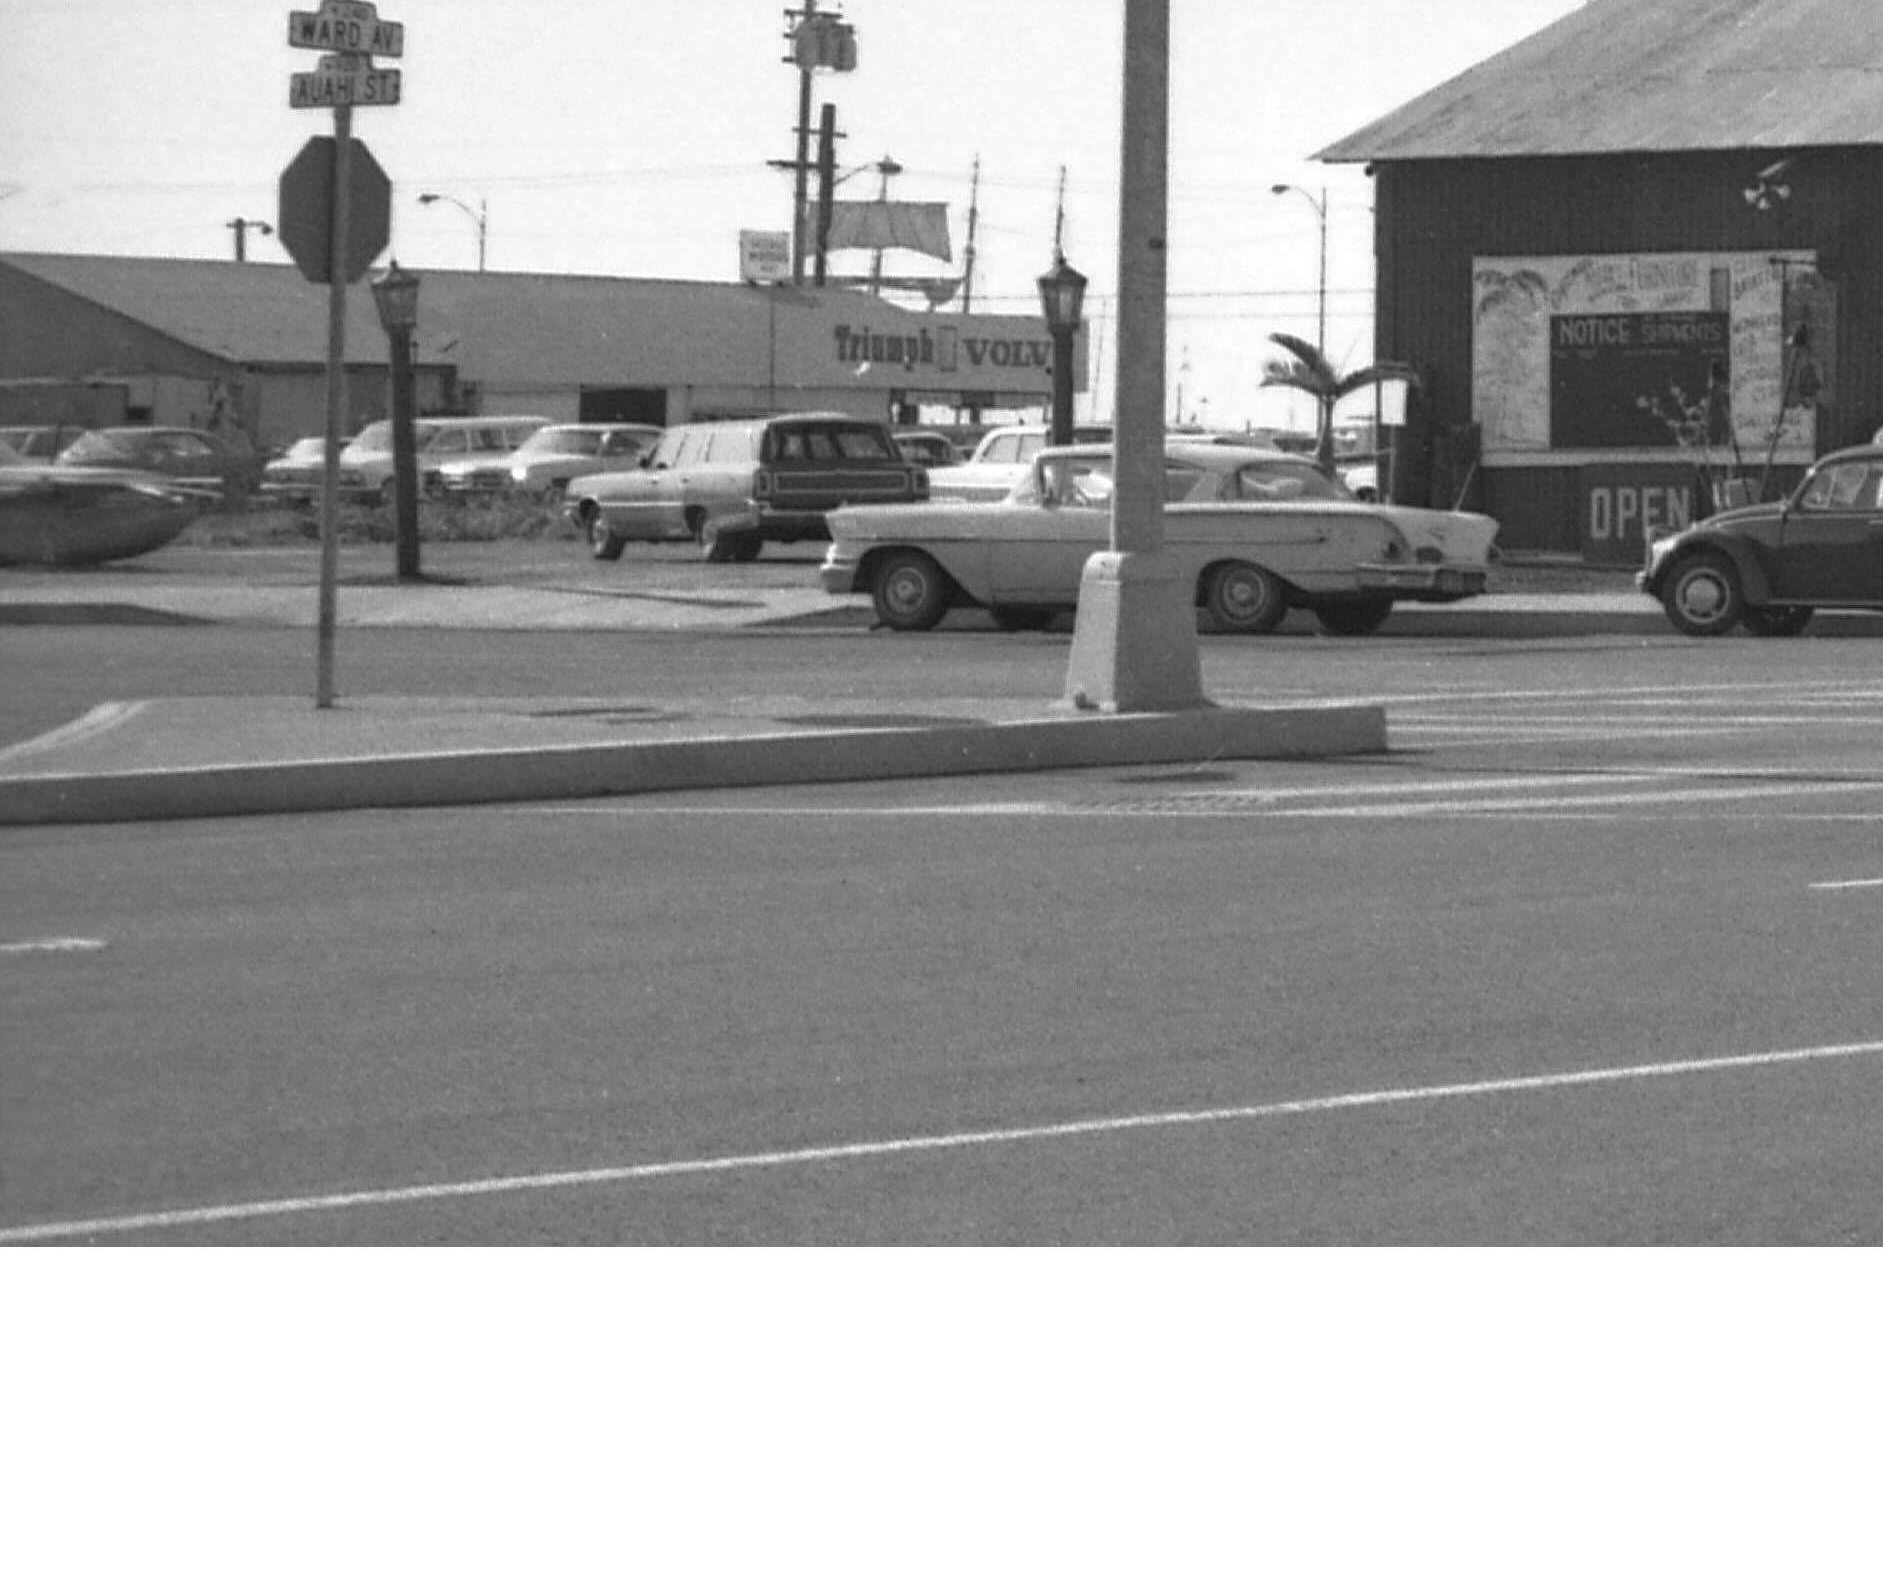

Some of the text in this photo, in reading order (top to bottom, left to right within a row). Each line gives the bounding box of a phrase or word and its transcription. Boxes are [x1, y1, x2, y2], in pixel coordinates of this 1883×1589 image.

[302, 18, 395, 51] WARD AV
[299, 73, 389, 103] AUAHI ST
[834, 325, 1051, 372] Triumph VOLV
[1559, 318, 1630, 347] NOTICE
[1590, 487, 1691, 541] OPEN
